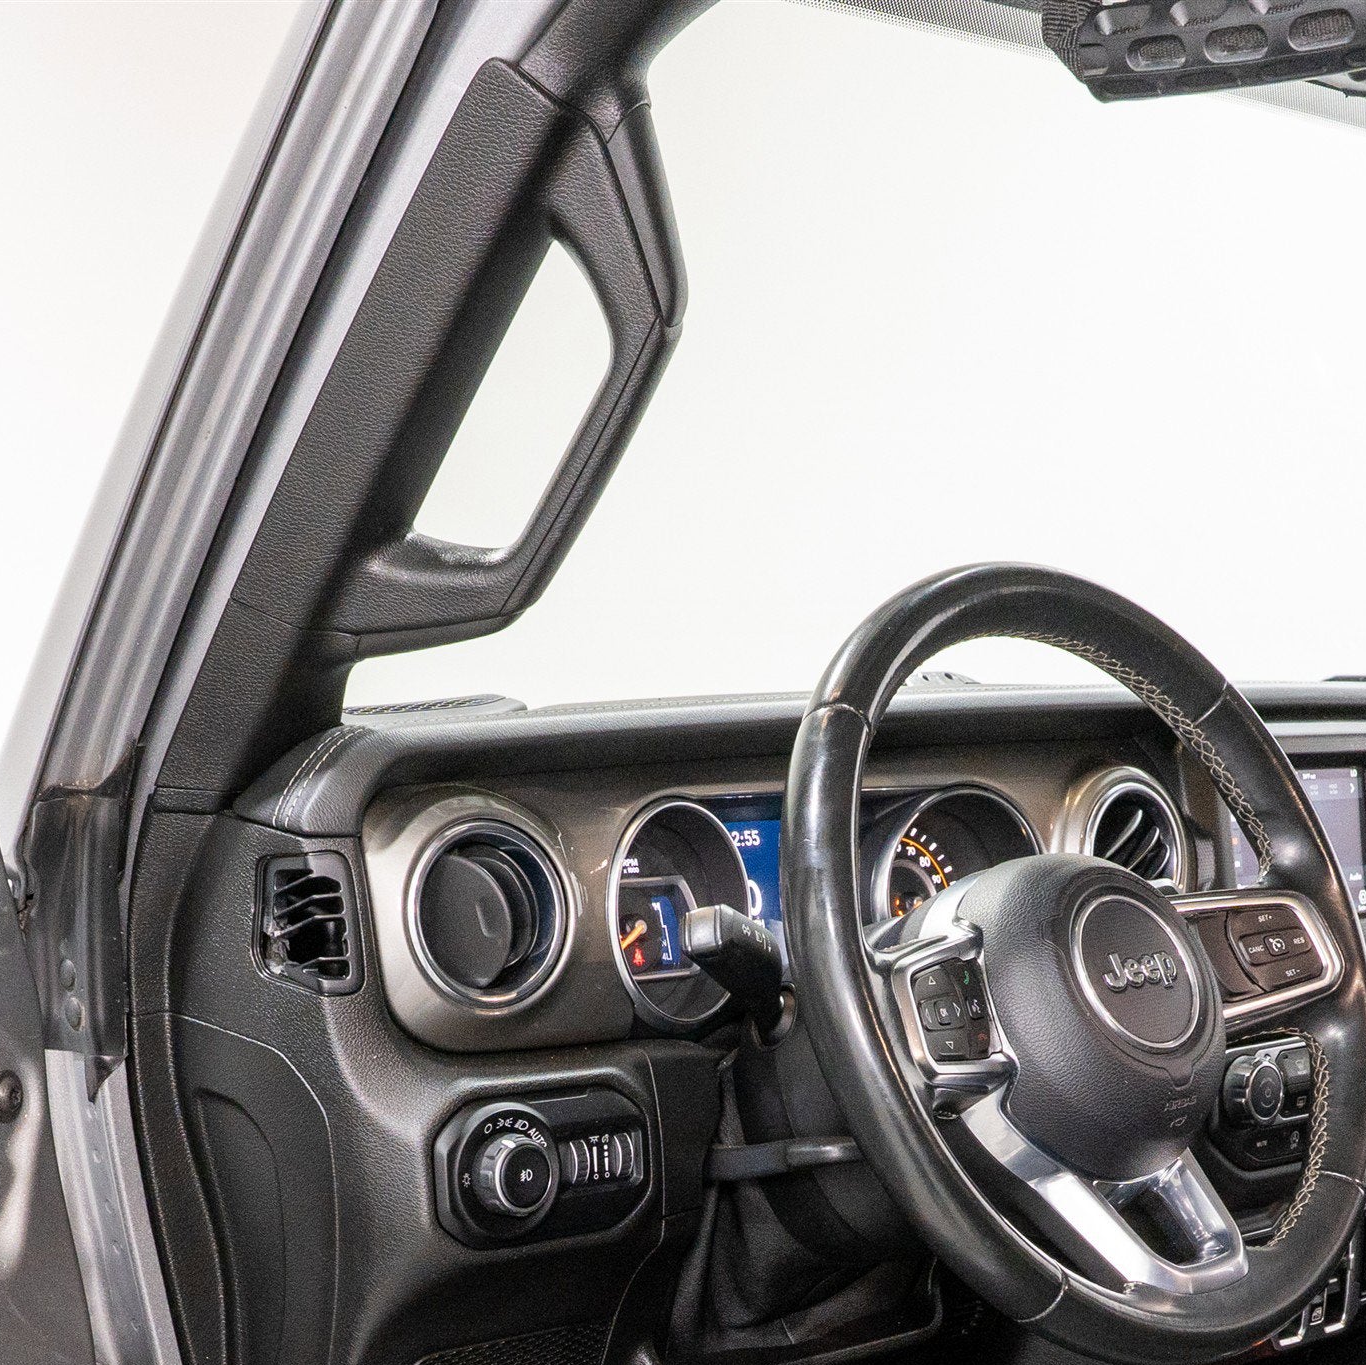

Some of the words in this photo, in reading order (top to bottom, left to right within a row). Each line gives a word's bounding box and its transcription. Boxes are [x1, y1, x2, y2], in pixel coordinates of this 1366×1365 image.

[919, 856, 931, 868] 80
[1292, 936, 1306, 945] RES
[1248, 945, 1265, 954] CANC
[1102, 952, 1177, 992] Jeep
